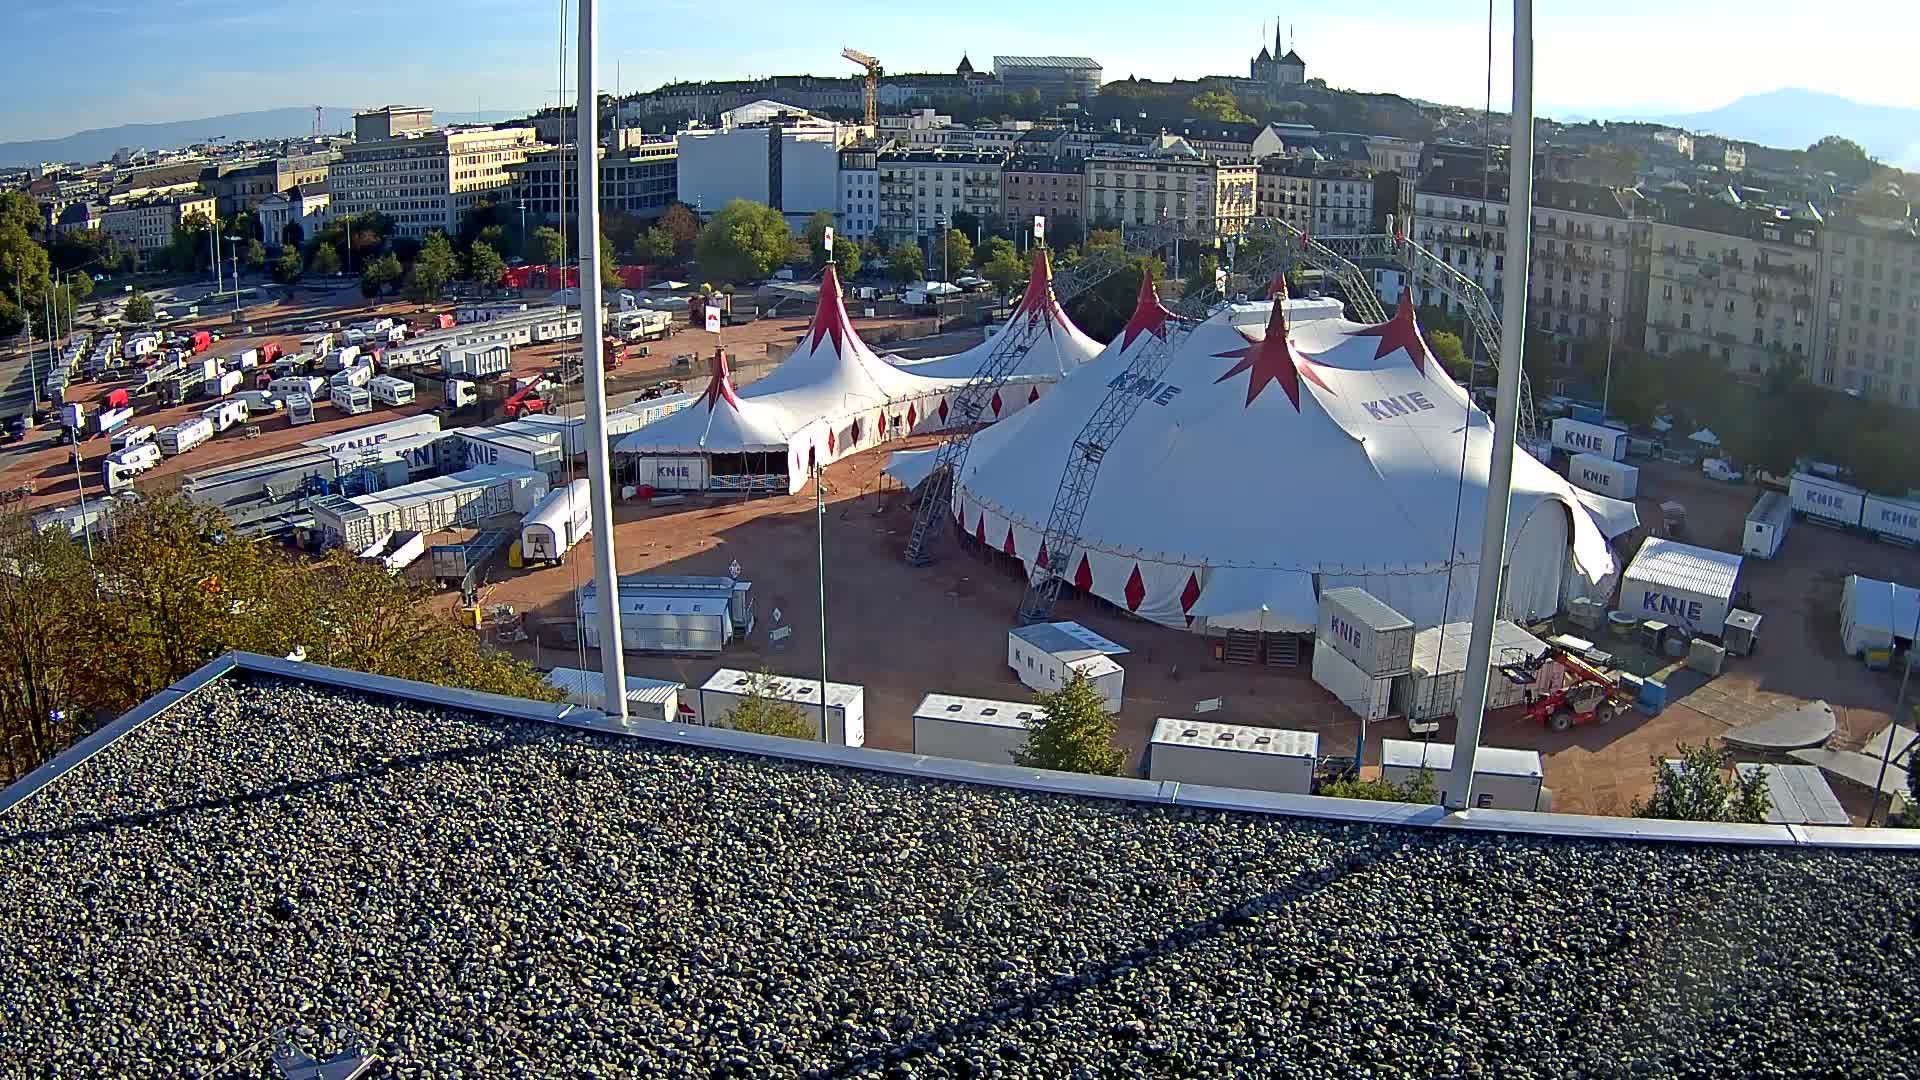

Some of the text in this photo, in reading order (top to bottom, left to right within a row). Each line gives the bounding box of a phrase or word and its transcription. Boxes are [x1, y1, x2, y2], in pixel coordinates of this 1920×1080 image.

[1361, 391, 1435, 421] KNIE
[1564, 430, 1602, 451] KNIE
[464, 441, 498, 465] KNIE
[657, 466, 689, 477] KNIE
[1583, 468, 1611, 486] KNIE
[1806, 489, 1843, 509] KNIE
[633, 603, 702, 612] NIE
[1642, 591, 1703, 621] KNIE
[1331, 615, 1362, 649] KNIE
[1015, 648, 1056, 682] KNIE
